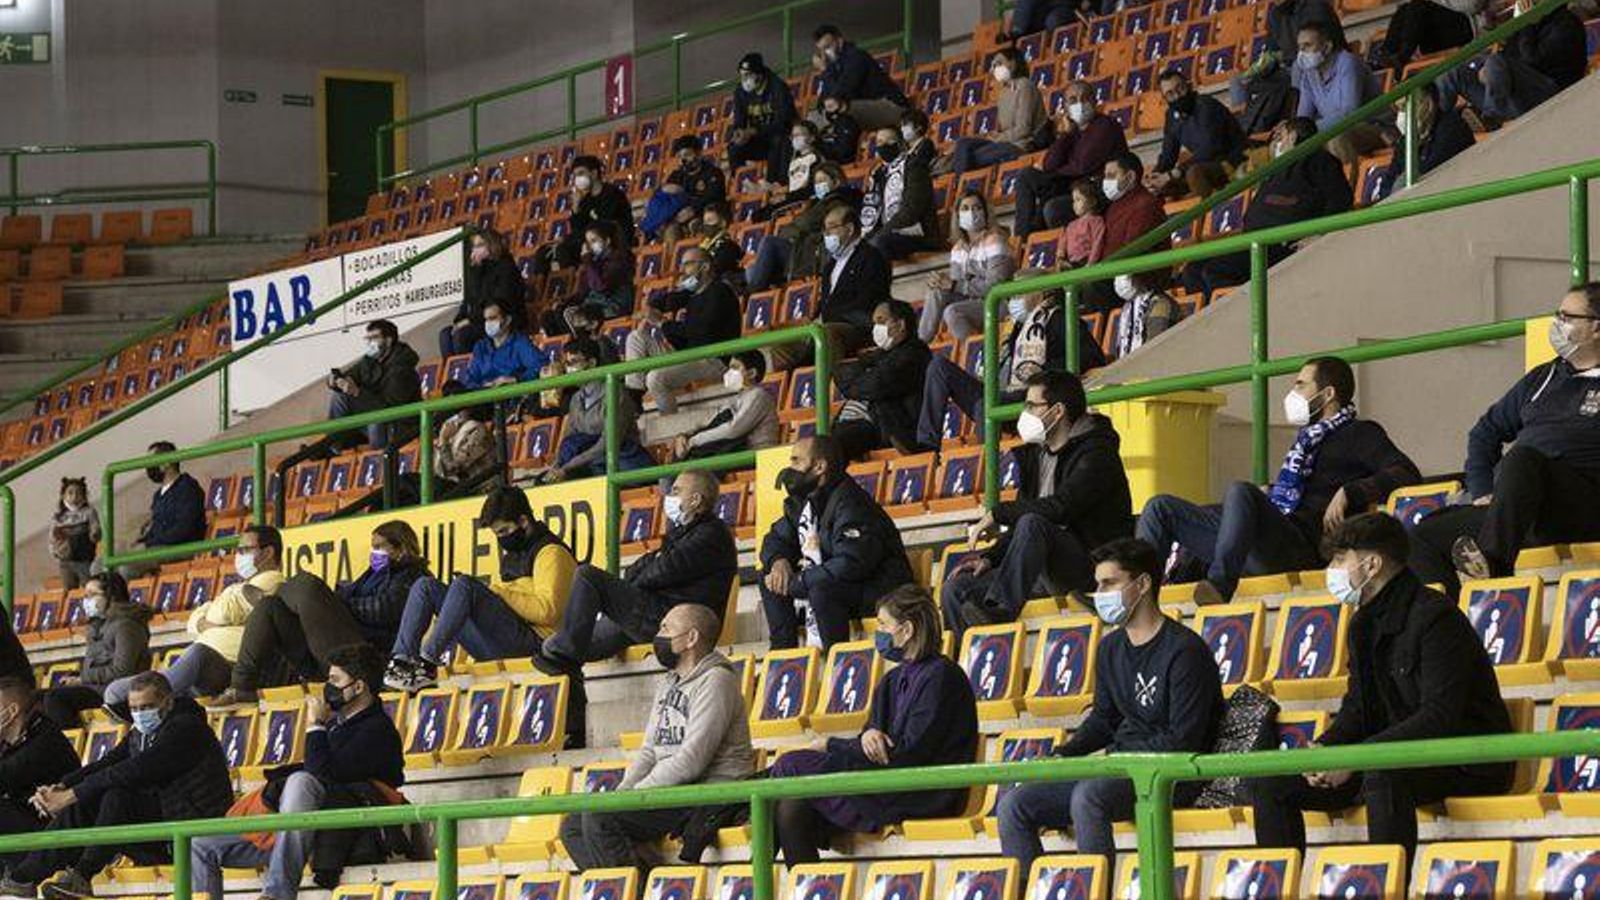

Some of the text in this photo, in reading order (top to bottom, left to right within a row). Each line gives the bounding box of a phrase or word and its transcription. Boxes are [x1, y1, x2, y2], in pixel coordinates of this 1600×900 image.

[354, 245, 417, 273] BOCADILLOS
[233, 274, 316, 341] BAR
[355, 278, 463, 315] PERRITOS HAMBURGUESAS
[286, 538, 354, 587] ISTA
